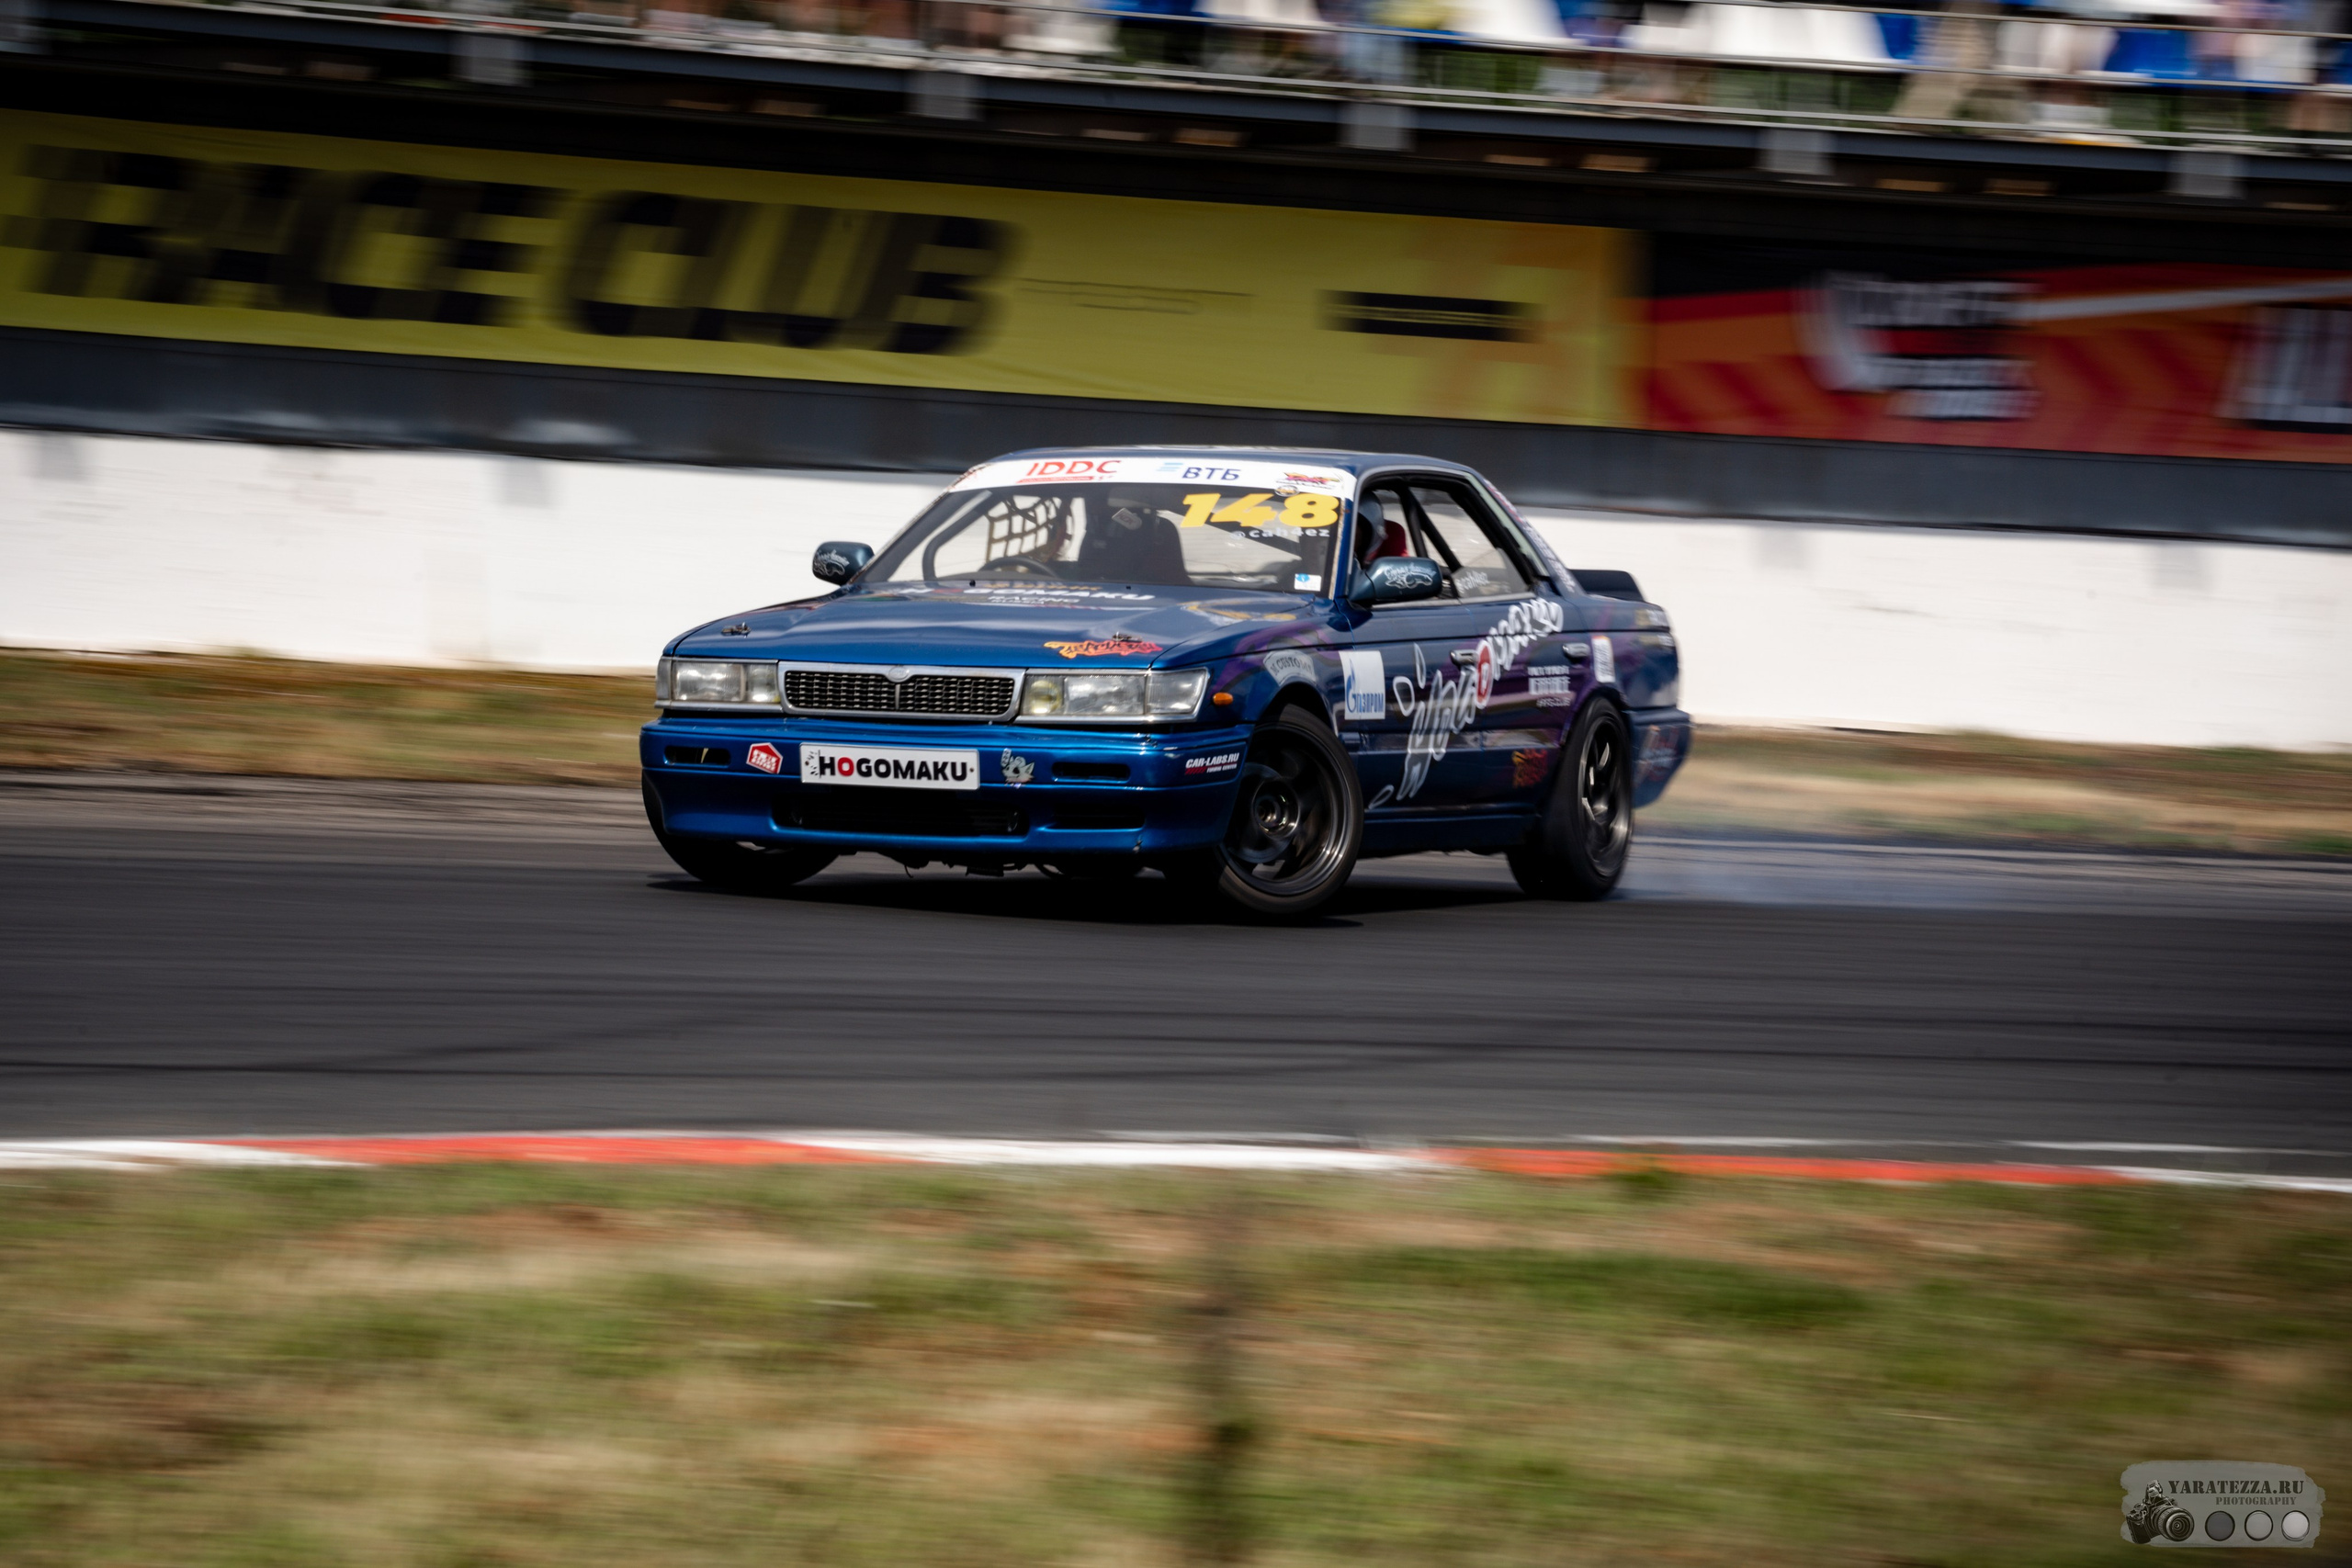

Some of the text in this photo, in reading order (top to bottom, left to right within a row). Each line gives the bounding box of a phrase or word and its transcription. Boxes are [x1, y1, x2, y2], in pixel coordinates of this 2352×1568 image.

[1026, 460, 1122, 476] IDDC
[1182, 467, 1241, 481] ВТБ
[1181, 492, 1340, 528] 148
[1185, 752, 1239, 768] CAR-LABS.RU
[820, 755, 967, 782] HOGOMAKU
